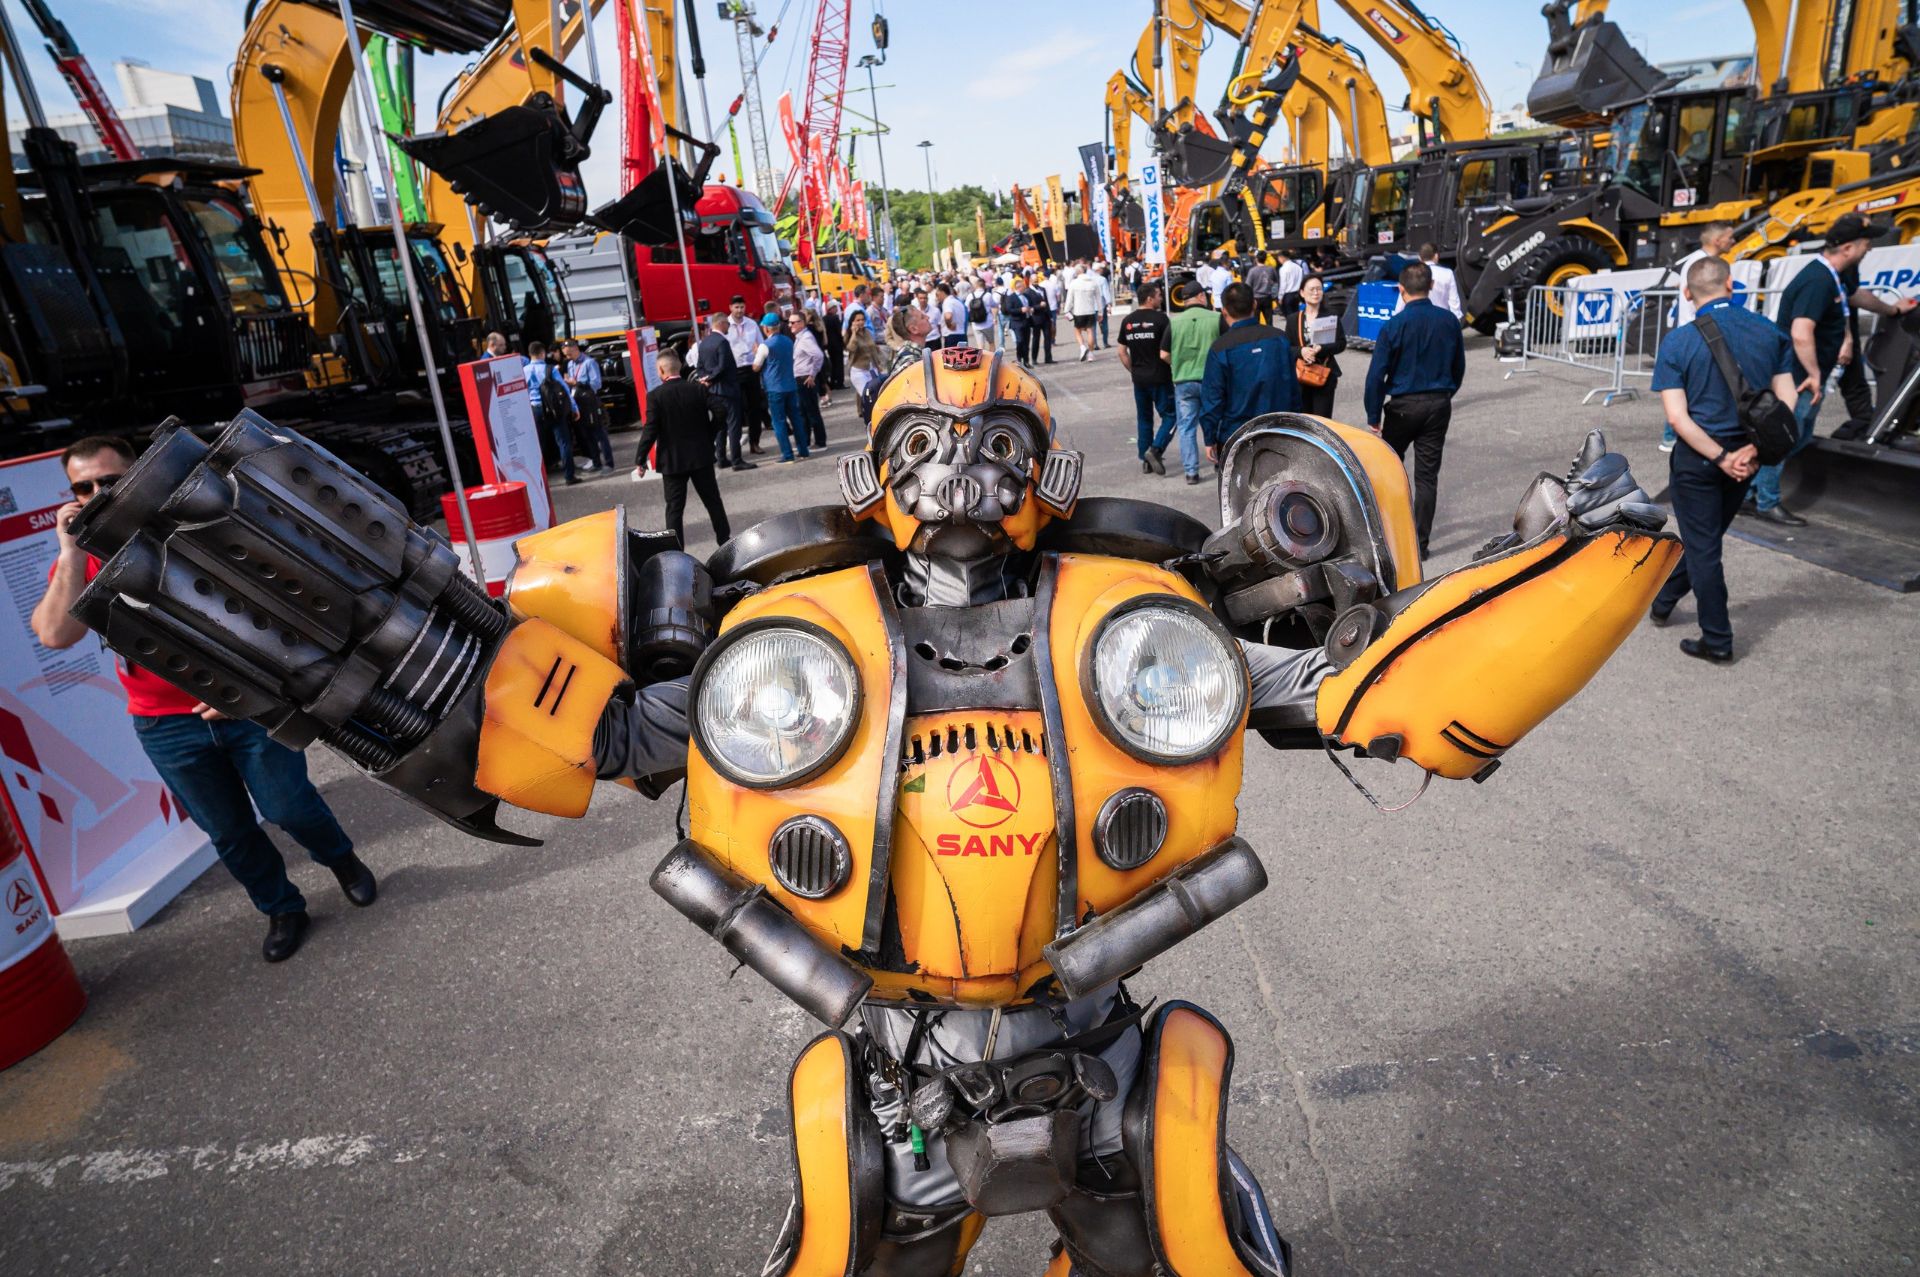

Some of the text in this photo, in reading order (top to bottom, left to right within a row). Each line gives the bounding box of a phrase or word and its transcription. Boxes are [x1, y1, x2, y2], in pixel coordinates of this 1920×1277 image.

[1147, 190, 1160, 253] XCMG
[1509, 231, 1546, 264] XCMG
[936, 832, 1042, 858] SANY
[15, 905, 42, 935] SANY
